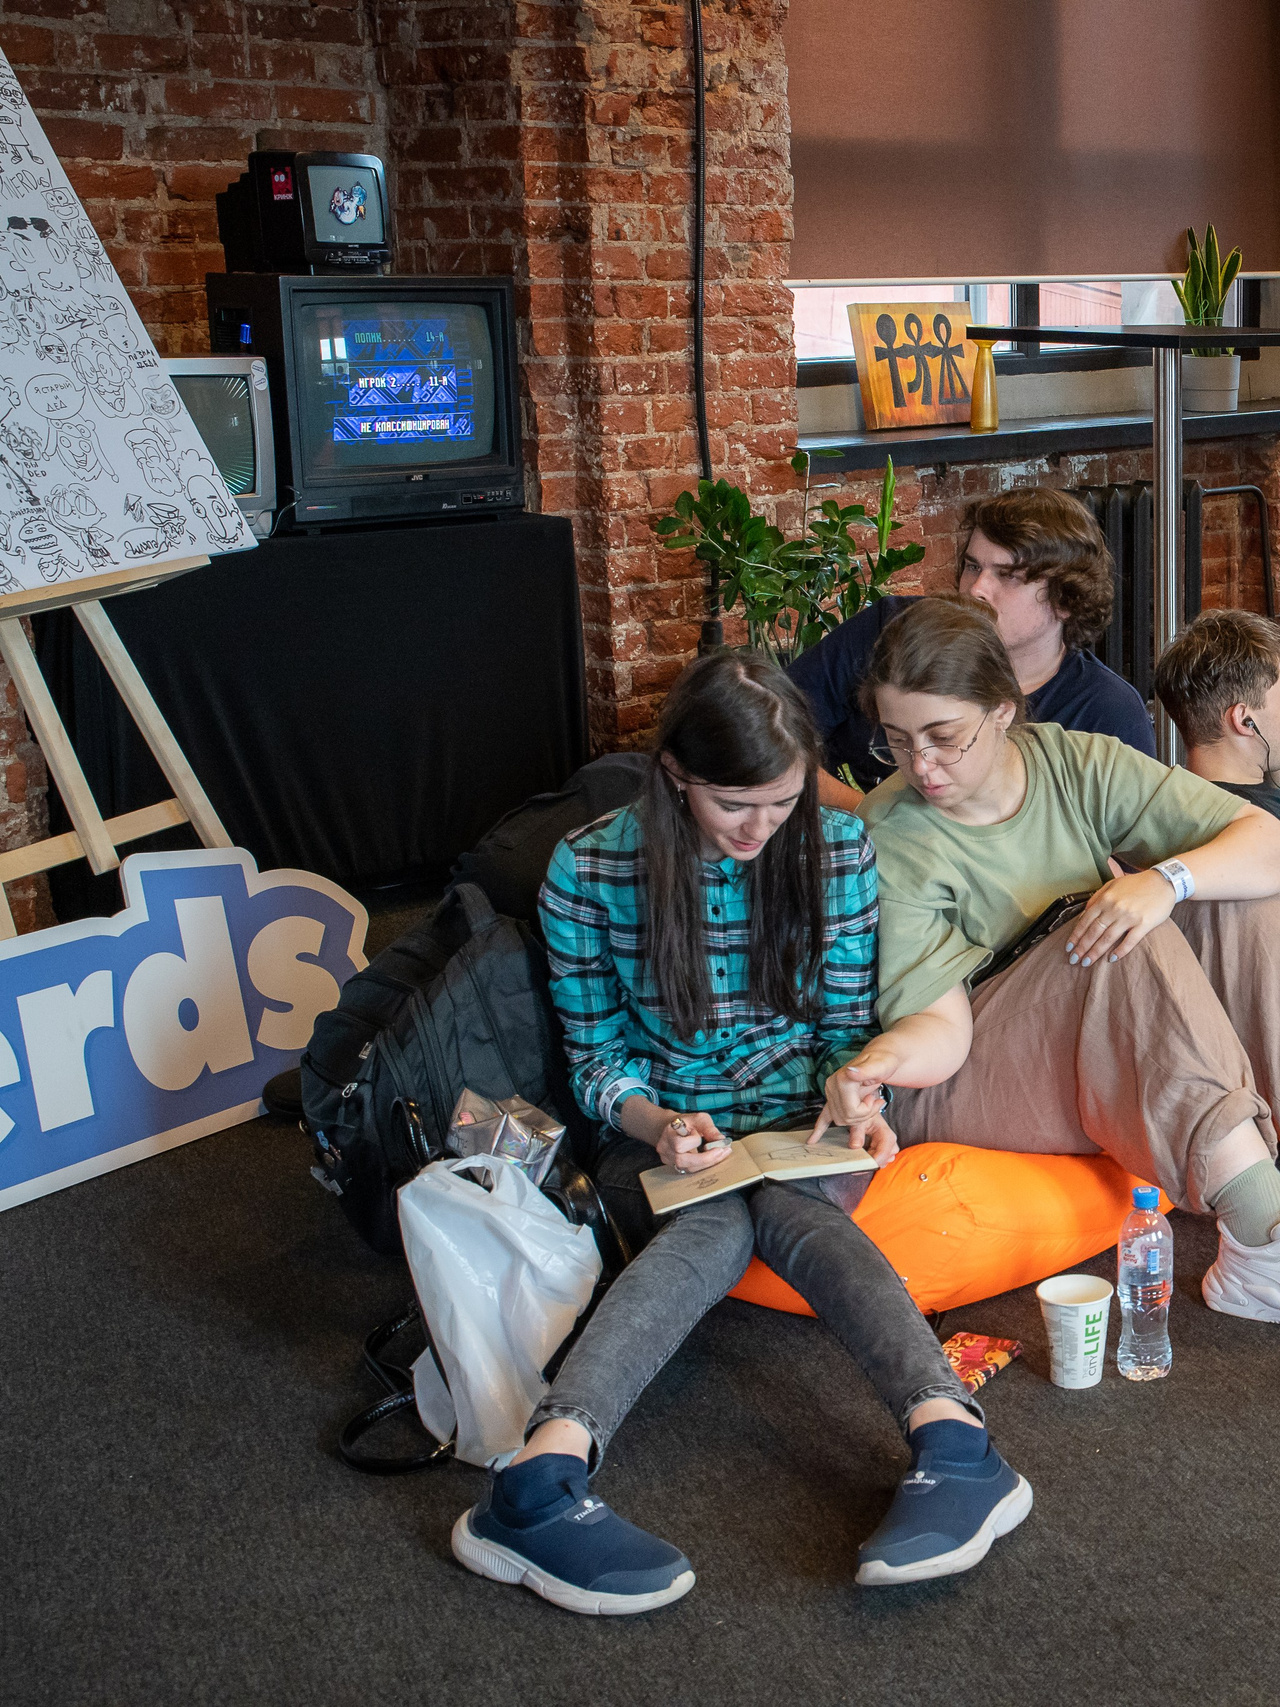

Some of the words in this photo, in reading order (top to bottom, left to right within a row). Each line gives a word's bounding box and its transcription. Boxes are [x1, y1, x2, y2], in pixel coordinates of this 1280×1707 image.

[34, 386, 41, 394] Я
[41, 380, 72, 394] СТАРЫЙ
[358, 377, 387, 389] ИГРОК
[46, 400, 67, 412] ДЕД
[360, 421, 372, 433] НЕ
[375, 419, 450, 432] КЛАССИФИЦИРОВАН
[0, 895, 341, 1143] rds
[1084, 1310, 1103, 1356] LIFE
[1088, 1355, 1098, 1377] CITY
